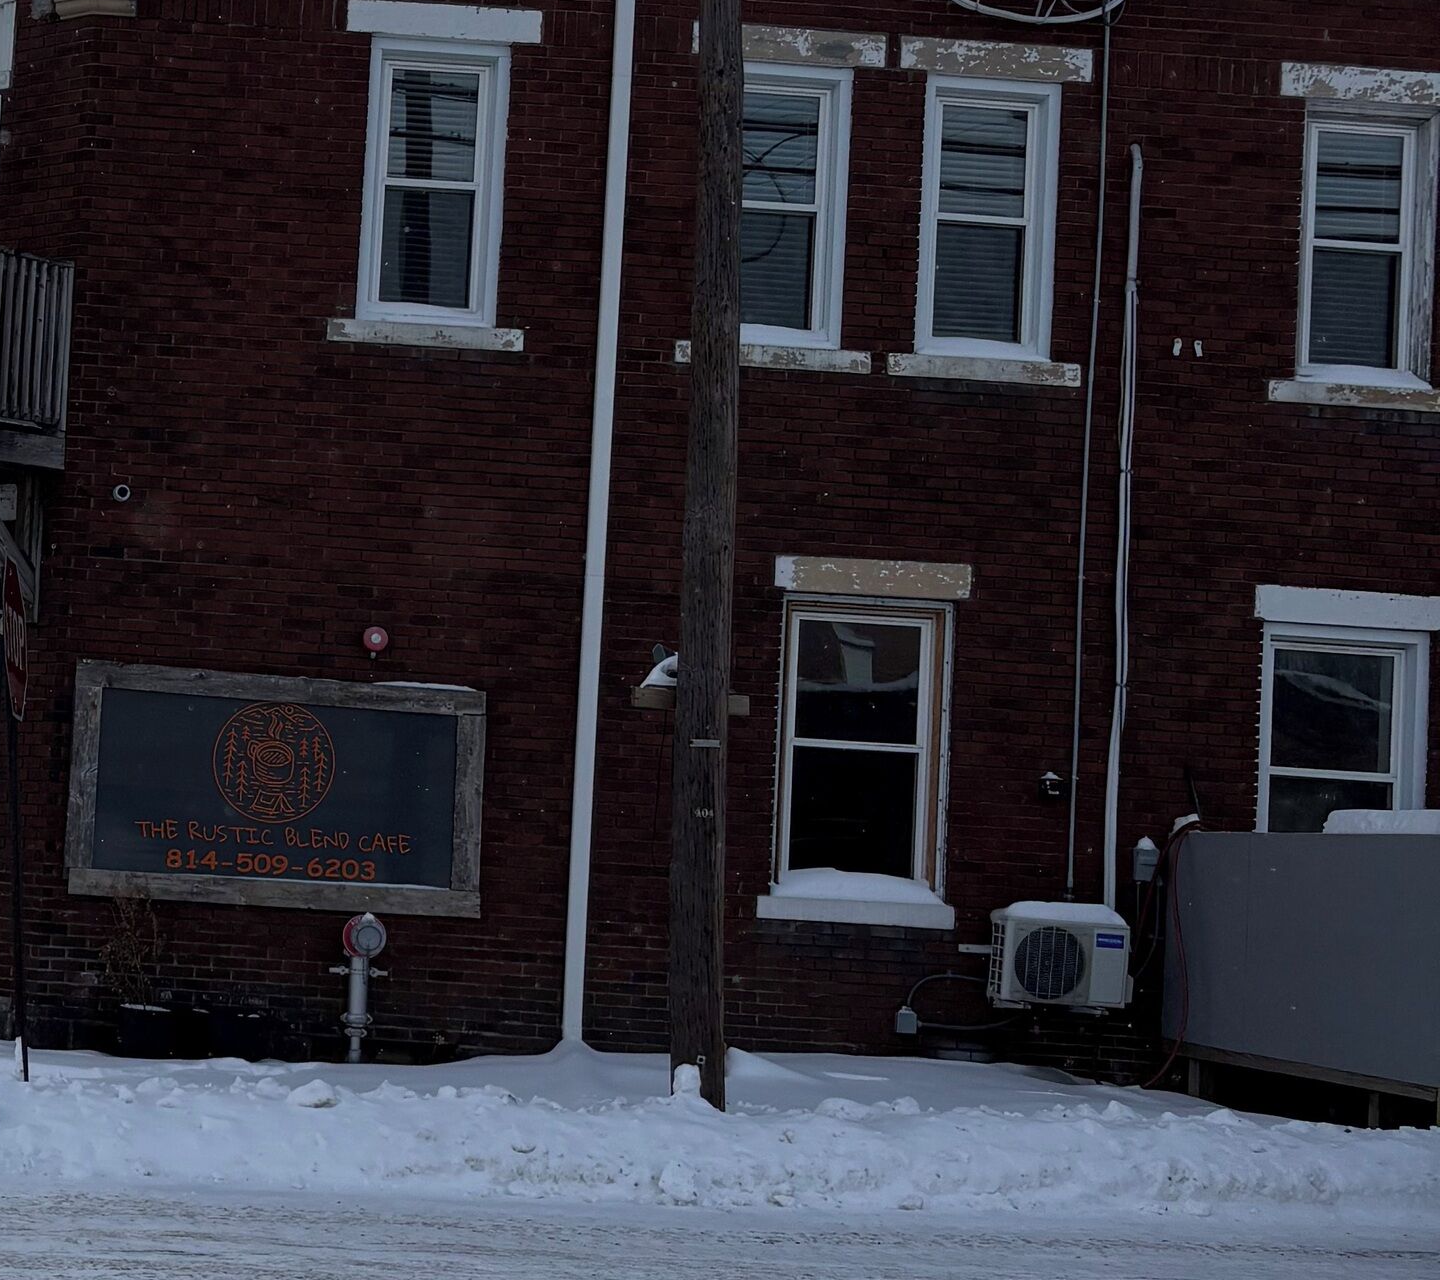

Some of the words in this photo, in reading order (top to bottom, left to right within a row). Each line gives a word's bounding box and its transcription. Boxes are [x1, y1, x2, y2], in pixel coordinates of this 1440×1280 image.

[134, 820, 178, 840] THE
[189, 820, 275, 845] RUSTIC
[284, 826, 350, 849] BLEND
[358, 832, 412, 854] CAFE
[165, 849, 376, 880] 814-509-6203
